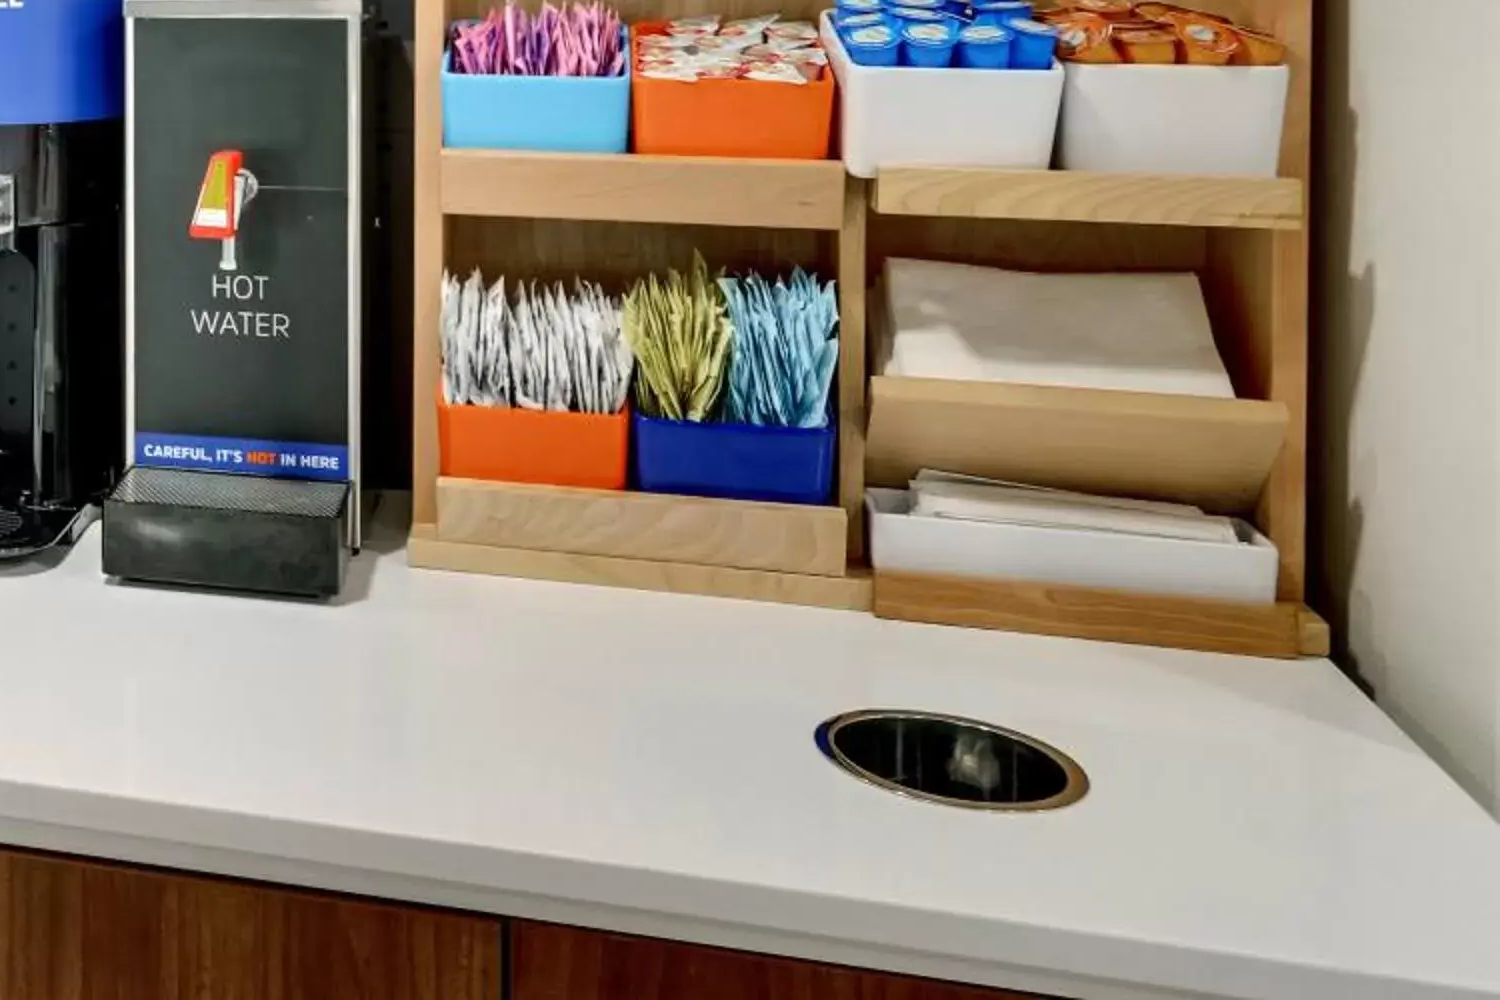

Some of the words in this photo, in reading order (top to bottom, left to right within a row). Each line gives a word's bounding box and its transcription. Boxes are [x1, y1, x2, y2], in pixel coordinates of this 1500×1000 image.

[212, 275, 269, 300] HOT
[190, 309, 290, 338] WATER
[143, 444, 212, 462] CAREFUL,
[216, 450, 243, 463] IT'S
[247, 451, 276, 465] HOT
[280, 453, 297, 467] IN
[300, 456, 339, 470] HERE
